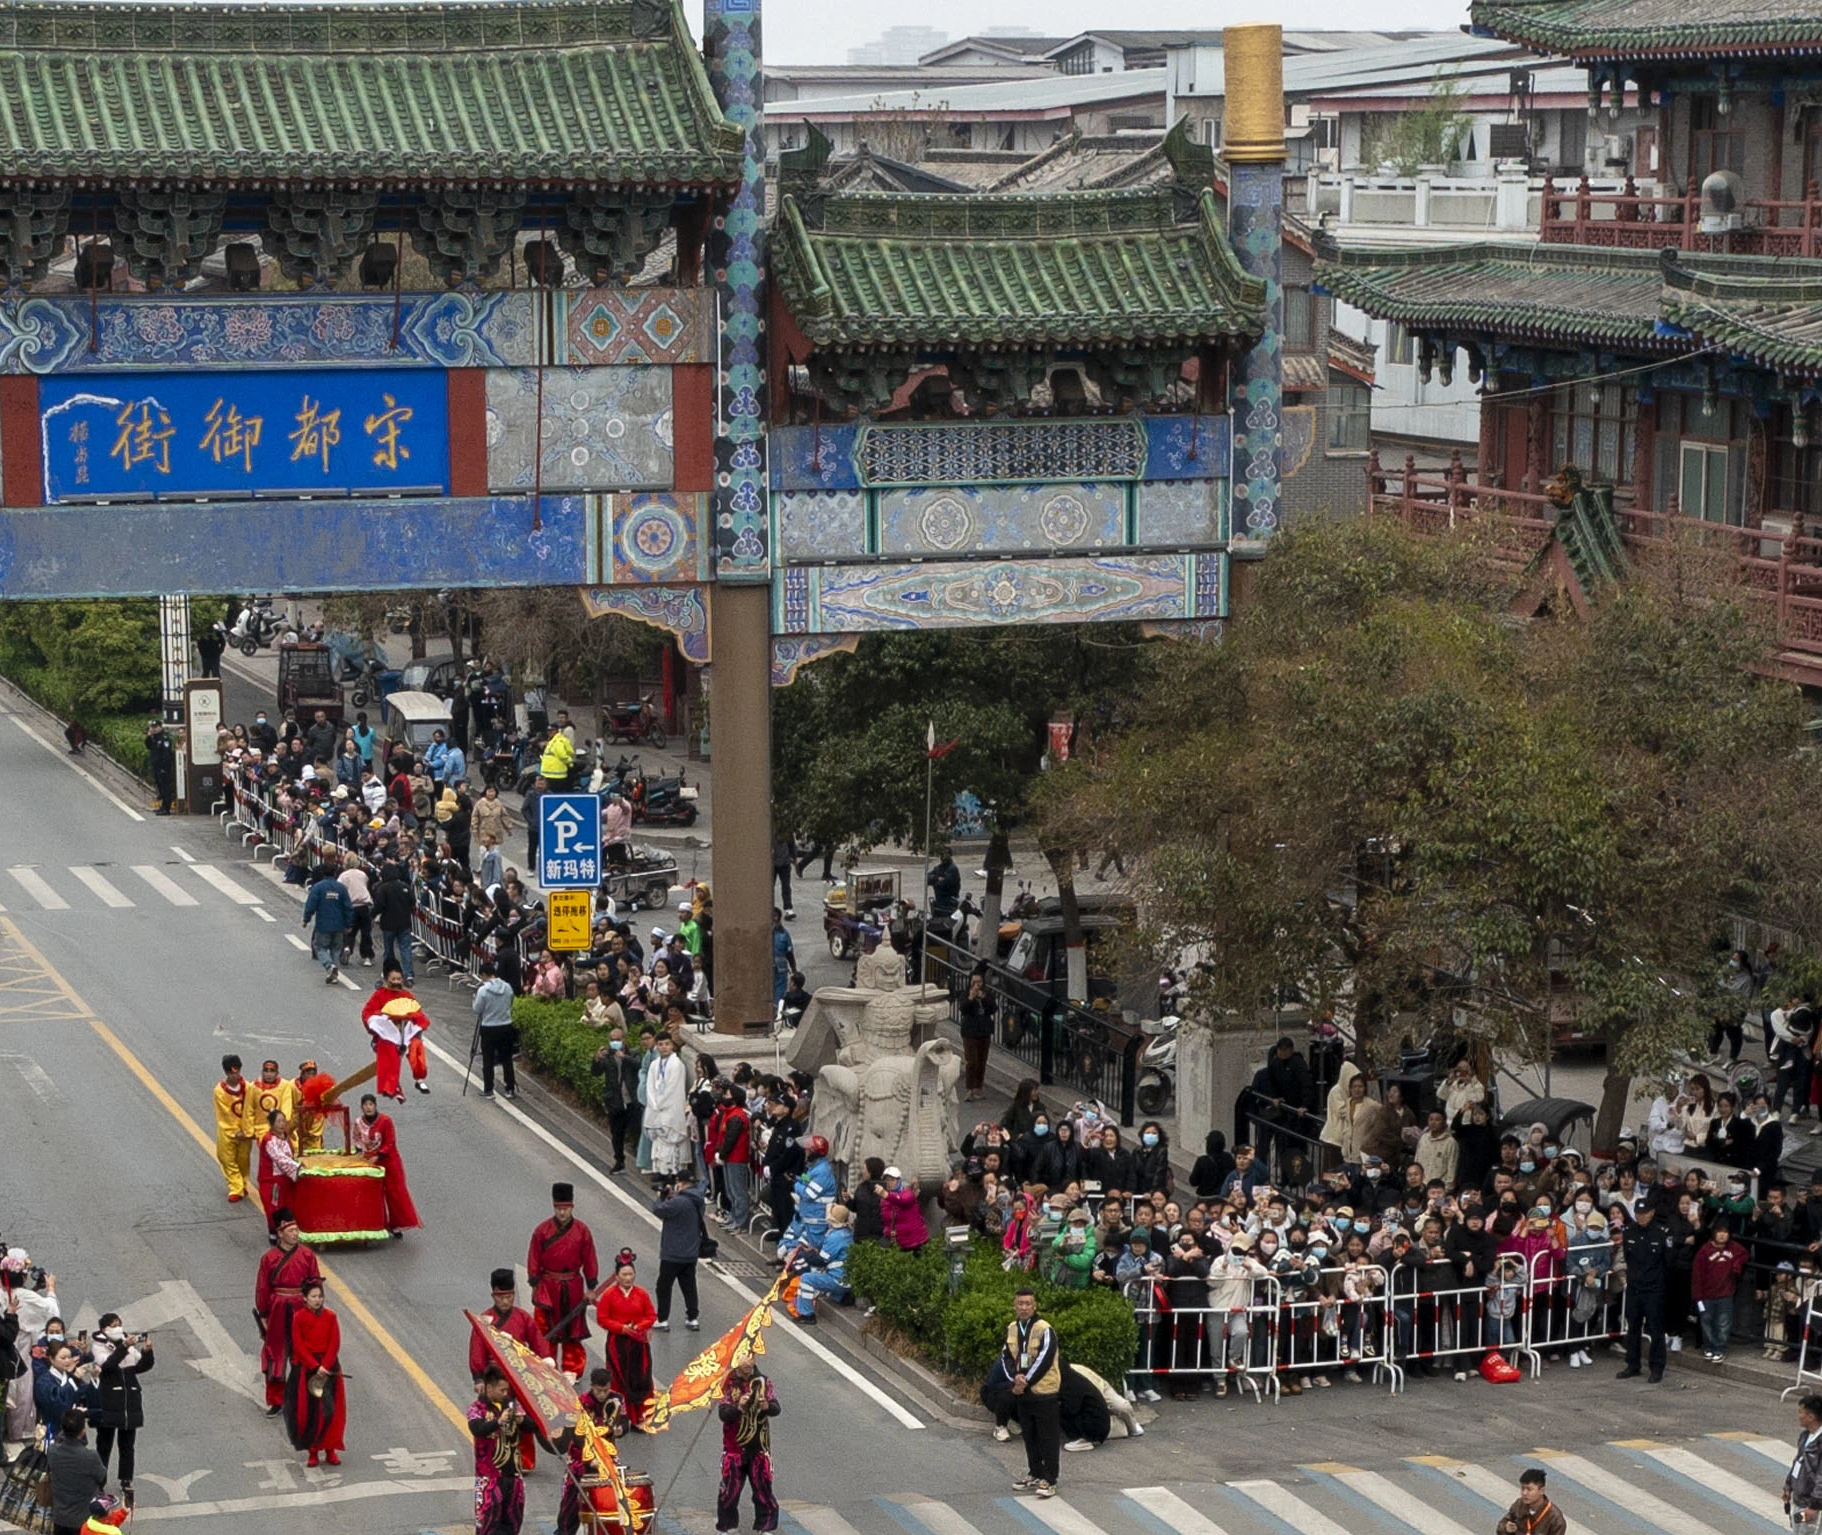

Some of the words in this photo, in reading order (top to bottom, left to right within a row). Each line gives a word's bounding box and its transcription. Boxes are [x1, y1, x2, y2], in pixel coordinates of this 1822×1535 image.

[111, 393, 412, 473] 宋都御街
[554, 821, 579, 854] P
[546, 858, 596, 880] 新玛特
